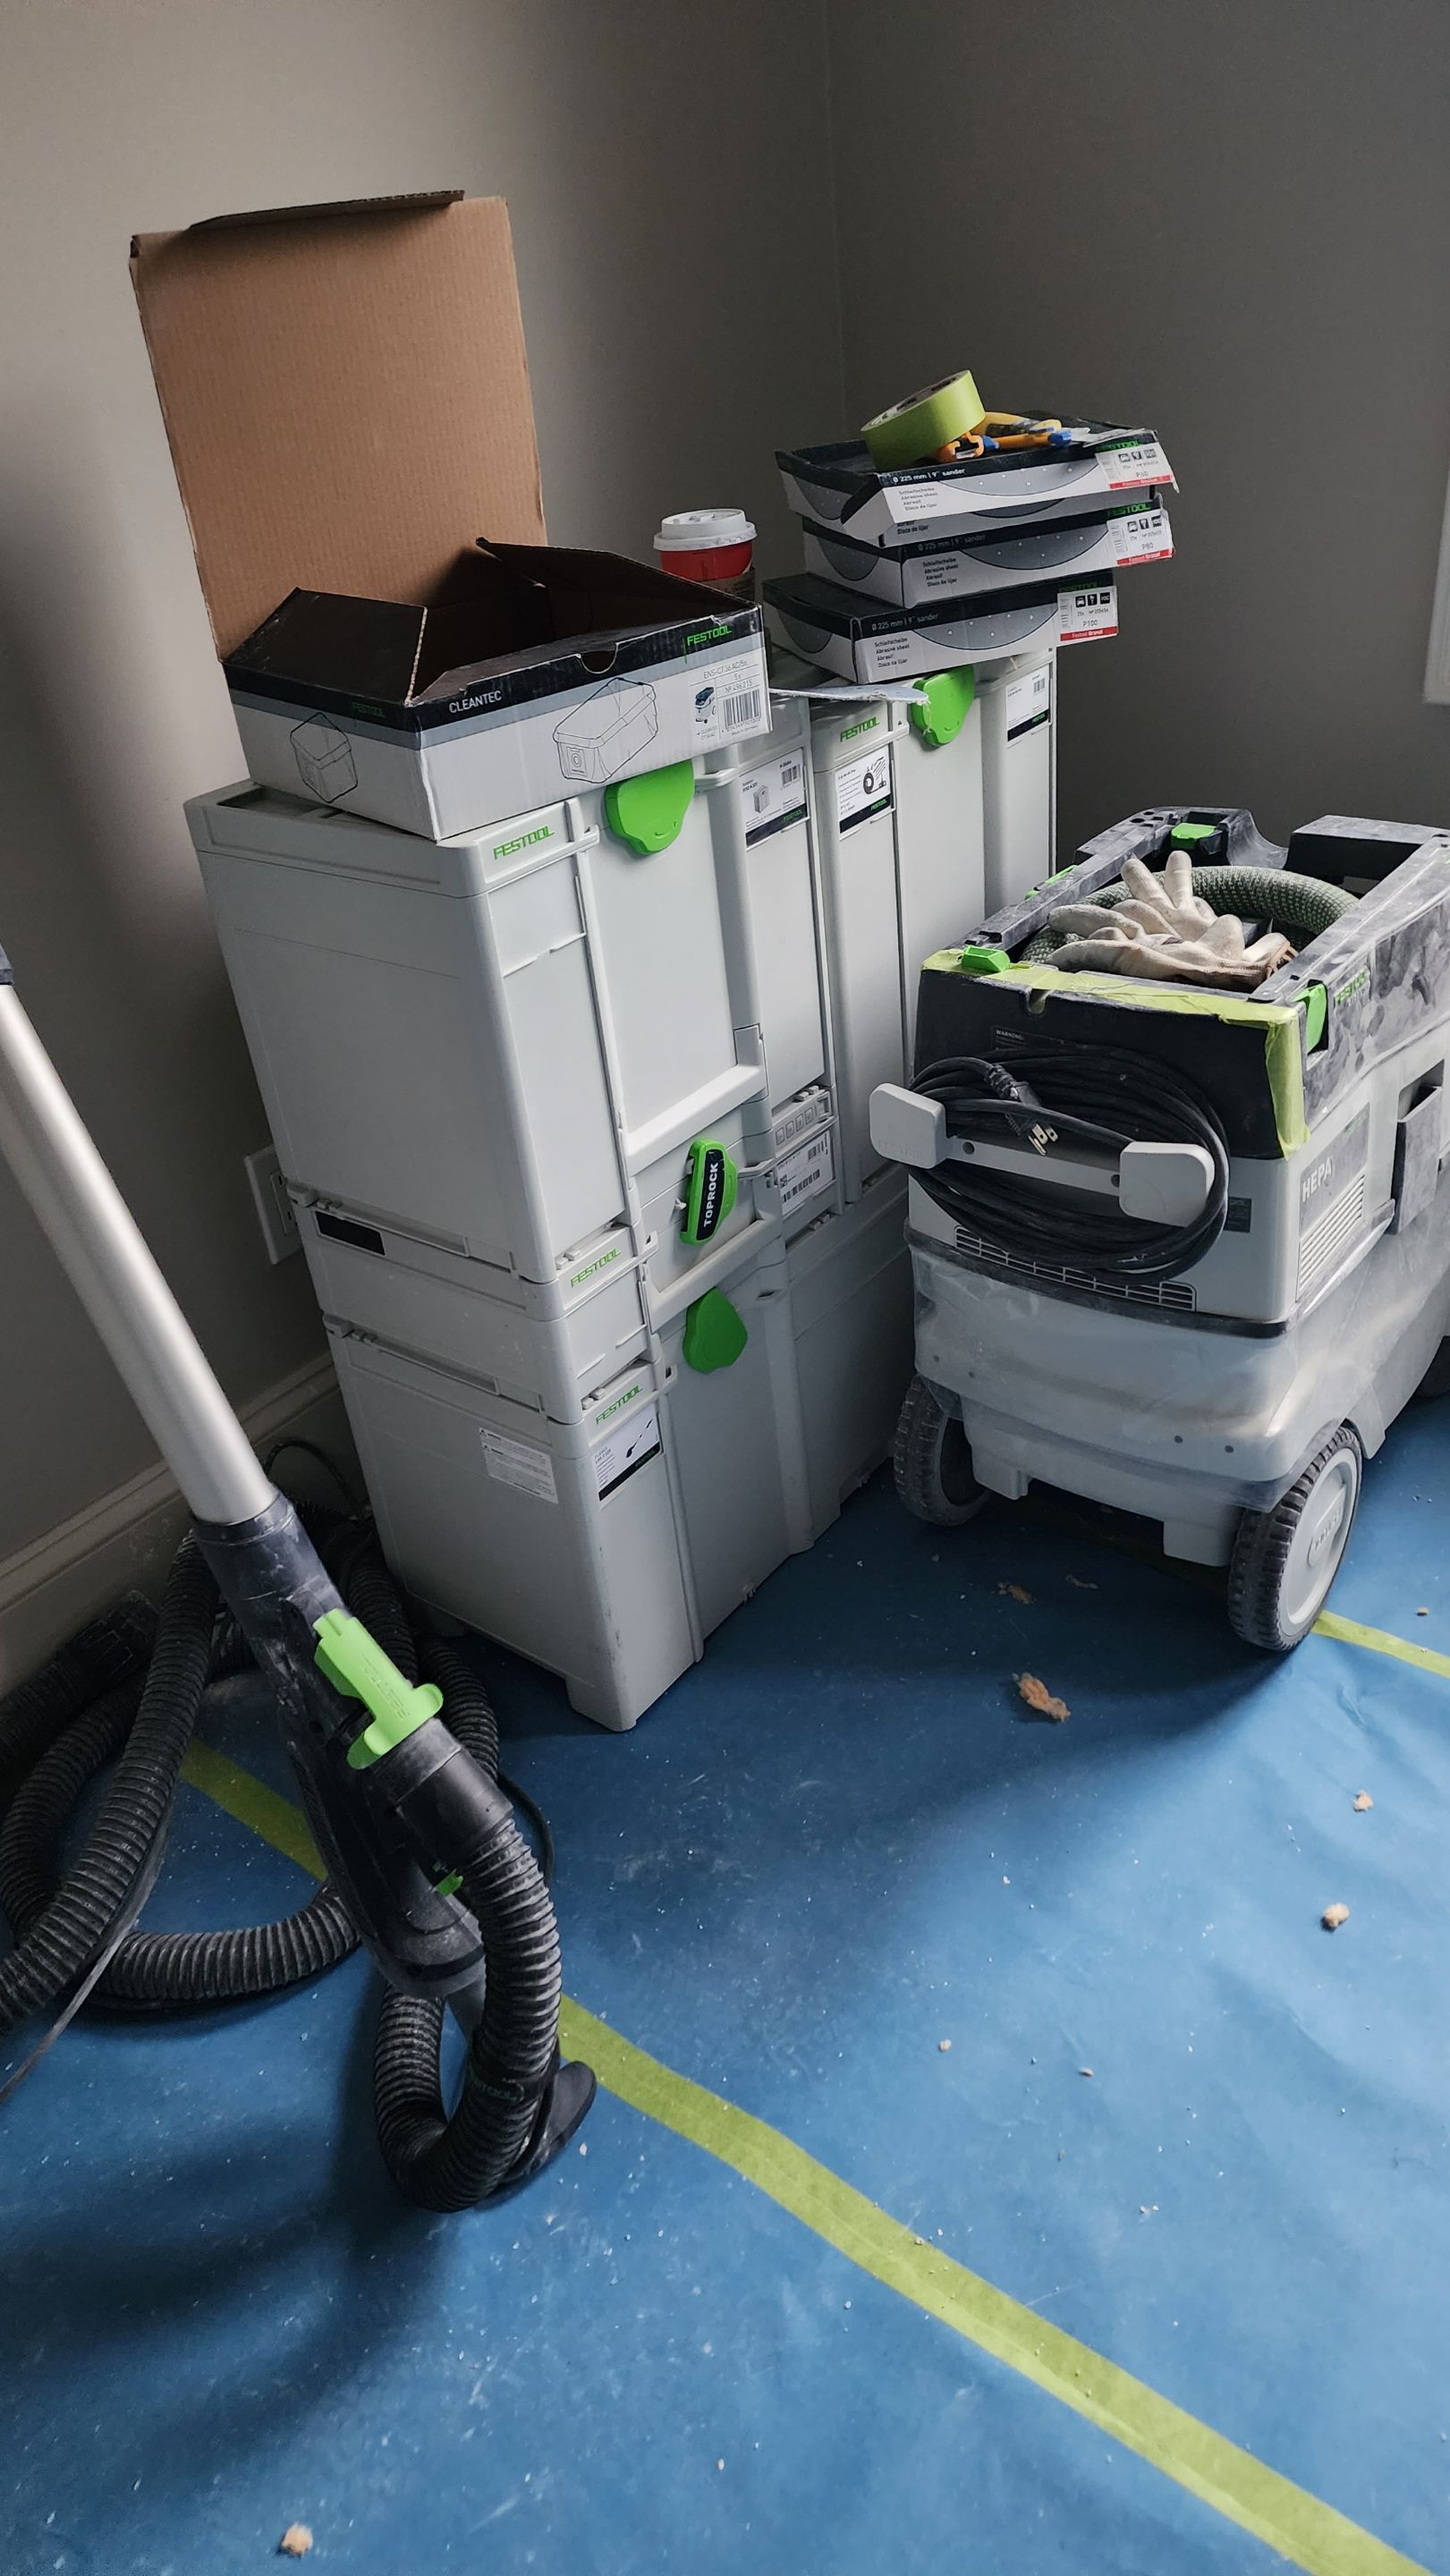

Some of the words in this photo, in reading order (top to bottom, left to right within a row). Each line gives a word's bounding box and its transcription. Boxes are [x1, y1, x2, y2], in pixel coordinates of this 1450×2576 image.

[900, 474, 912, 482] 225
[925, 542, 937, 550] 225
[937, 540, 950, 548] mm
[965, 534, 986, 542] sander
[878, 622, 889, 630] 225
[890, 620, 903, 628] mm
[916, 614, 938, 623] sander
[1083, 619, 1098, 627] P100
[687, 625, 732, 646] FESTOOL
[449, 690, 503, 714] CLEANTEC
[840, 716, 880, 743] FESTOOL
[493, 825, 555, 860] FESTOOL
[1302, 1157, 1332, 1203] HEPA
[703, 1162, 719, 1228] TOPROCK
[571, 1248, 622, 1288] FESTOOL
[596, 1384, 643, 1425] FESTOOL
